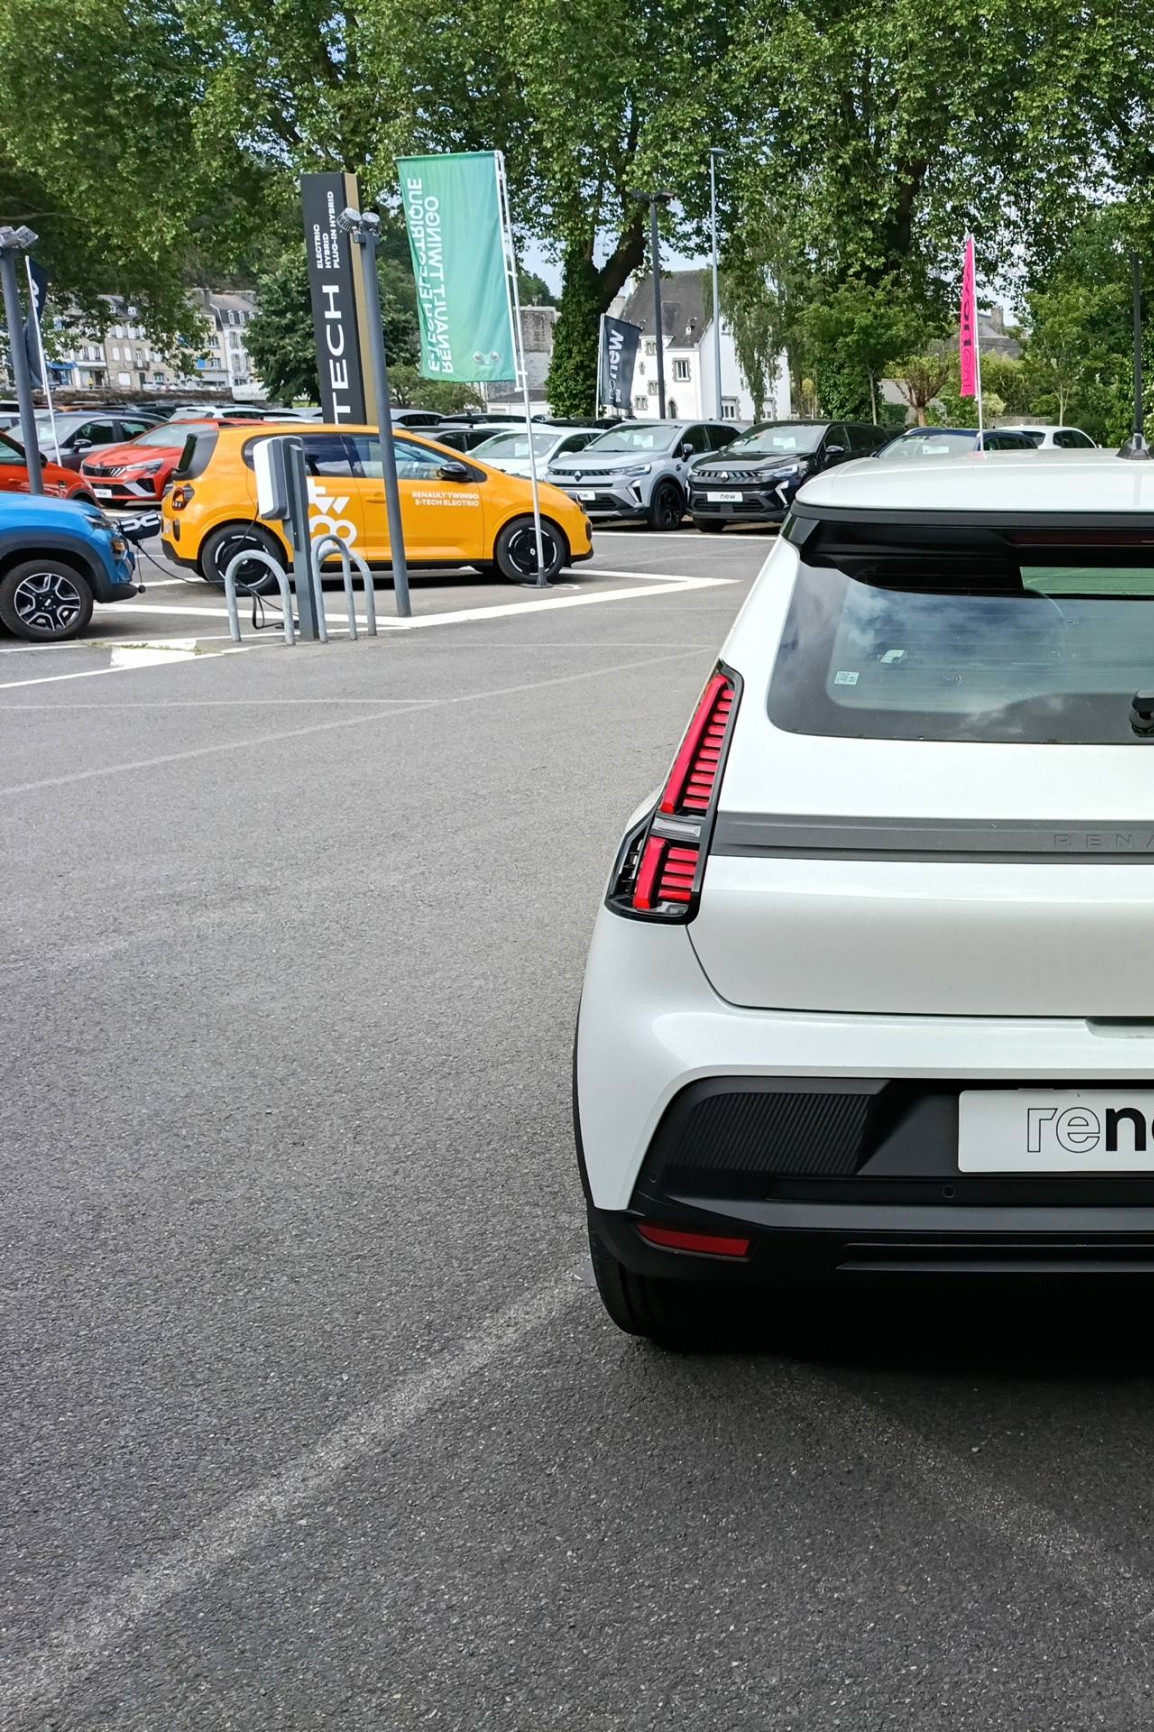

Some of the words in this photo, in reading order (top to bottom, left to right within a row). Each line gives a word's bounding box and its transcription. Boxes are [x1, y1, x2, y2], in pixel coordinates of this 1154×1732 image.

[327, 190, 337, 227] HYBRID
[313, 224, 324, 269] ELECTRIC
[322, 233, 332, 269] HYBRID
[330, 228, 340, 269] PLUG-IN
[412, 491, 447, 499] RENAULT
